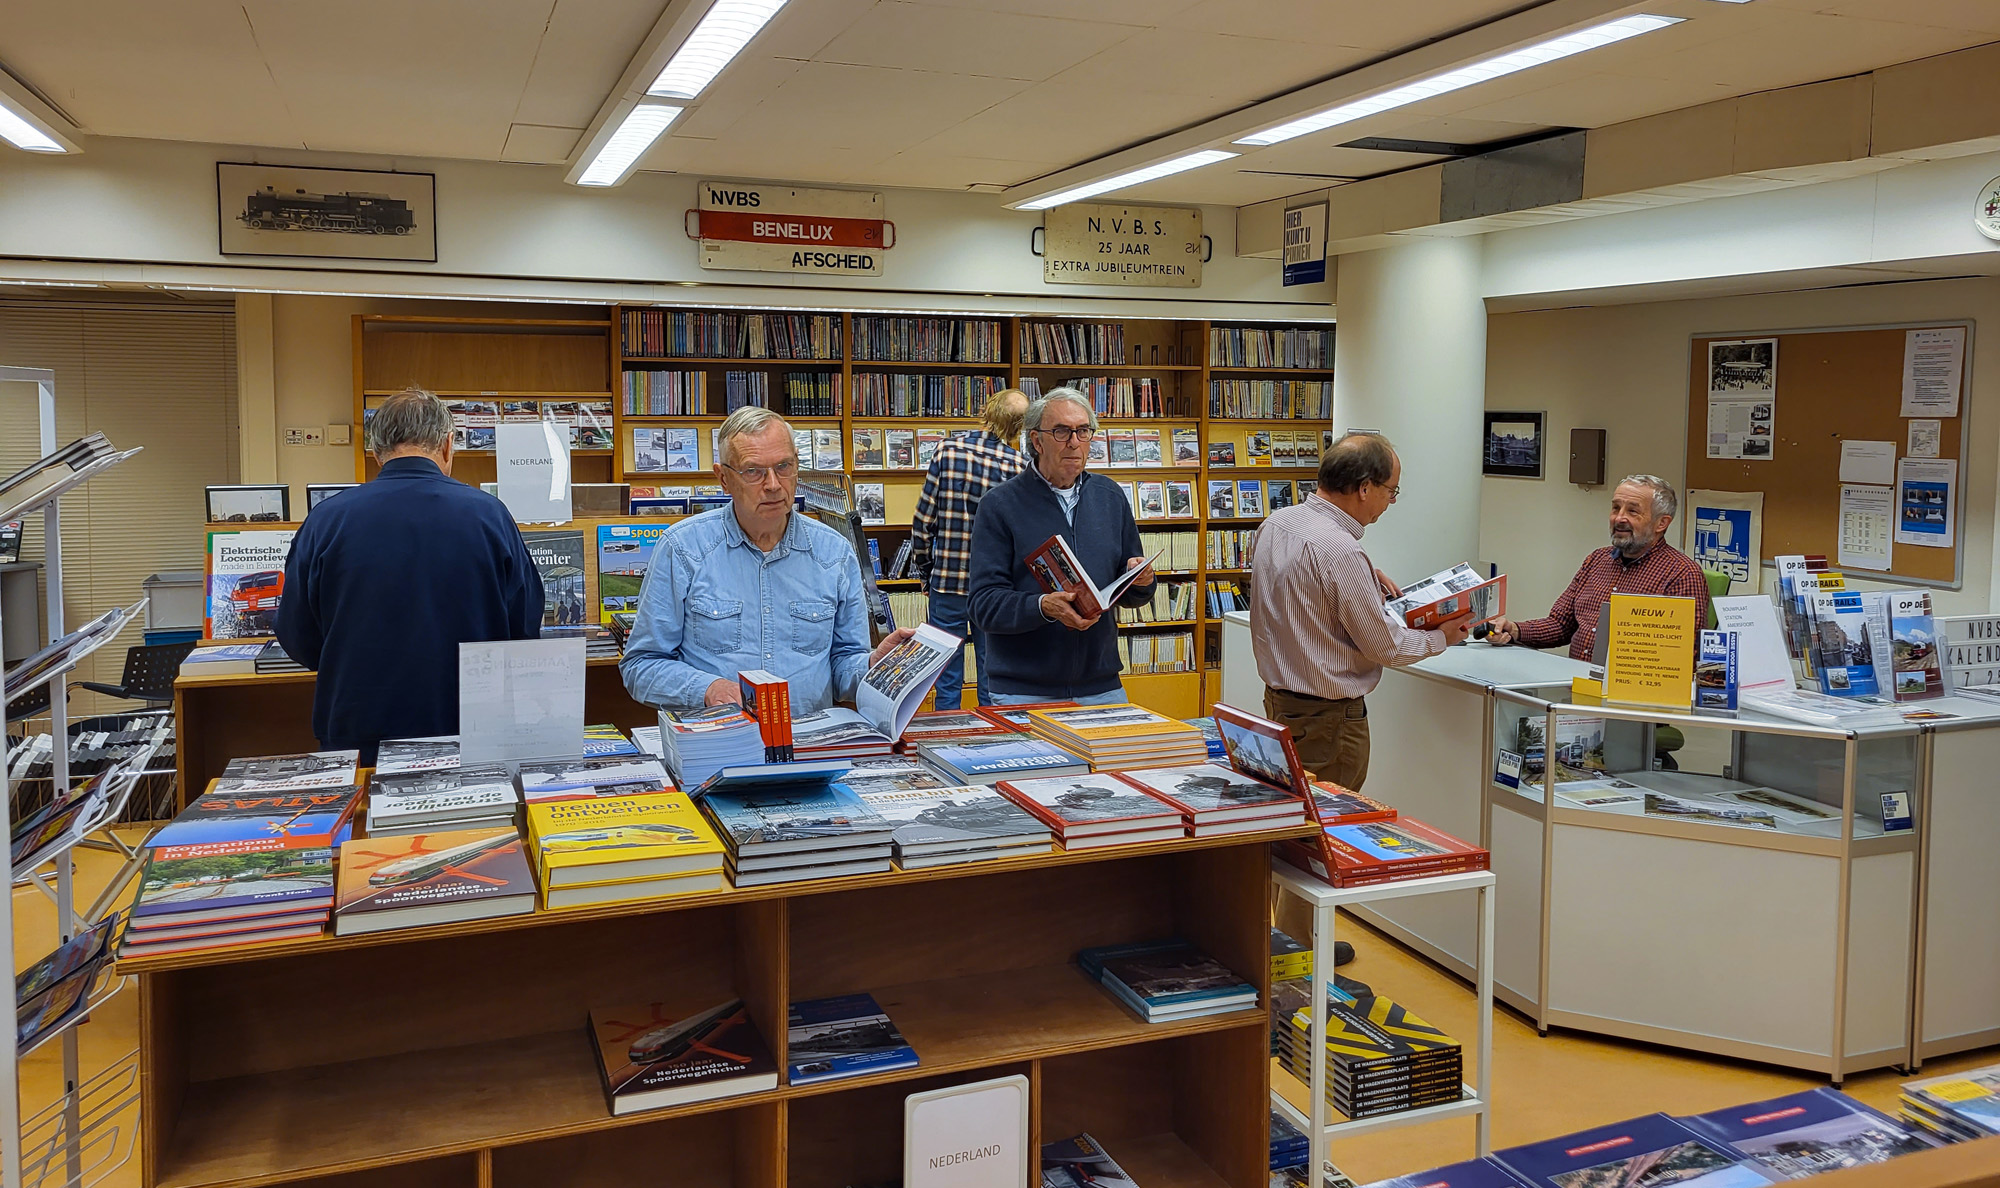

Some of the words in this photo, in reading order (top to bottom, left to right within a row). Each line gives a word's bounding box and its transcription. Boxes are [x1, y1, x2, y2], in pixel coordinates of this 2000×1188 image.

[711, 190, 761, 207] NVBS
[1088, 217, 1105, 233] N.
[1112, 218, 1126, 234] V.
[1134, 219, 1147, 235] B.
[1154, 220, 1167, 236] S.
[1286, 211, 1302, 229] HIER
[752, 221, 833, 240] BENELUX
[1286, 227, 1304, 246] KUNT
[1305, 226, 1311, 243] U
[1098, 242, 1112, 253] 25
[1119, 243, 1151, 256] JAAR
[1286, 244, 1311, 263] PINNEN
[1053, 261, 1091, 272] EXTRA
[1095, 262, 1185, 275] JUBILEUMTREIN
[509, 457, 554, 466] NEDERLAND
[668, 488, 690, 496] AyrLine
[220, 546, 282, 555] Elektrische
[527, 547, 553, 555] tation
[220, 554, 288, 563] Locomotieve
[533, 555, 571, 565] venter
[220, 562, 244, 570] made
[246, 562, 254, 570] in
[1786, 562, 1796, 570] OP
[1801, 580, 1809, 588] OP
[1810, 580, 1818, 588] DE
[1819, 580, 1840, 588] RAILS
[1899, 601, 1913, 609] OP
[1631, 608, 1665, 618] NIEUW
[1642, 622, 1682, 631] WERKLAMPJE
[1968, 621, 2000, 639] NVBS
[1623, 631, 1651, 639] SOORTEN
[1703, 647, 1727, 655] NVBS
[971, 755, 1071, 771] AMSTERDAM
[862, 791, 925, 801] Stoom
[926, 789, 954, 798] bij
[955, 786, 982, 794] NS
[201, 794, 342, 810] ATLAS
[548, 800, 636, 812] Treinen
[550, 802, 680, 819] ontwerpen
[578, 814, 631, 822] Nederlandse
[164, 851, 182, 859] in
[185, 843, 285, 858] Nederland
[165, 838, 276, 853] Kopstations
[393, 884, 481, 898] Nederlandse
[436, 881, 463, 890] jaar
[254, 891, 284, 899] Frank
[374, 886, 499, 905] Spoorwegaffiches
[1361, 1055, 1408, 1068] WAGENWERKPLAATS
[642, 1064, 746, 1084] Spoorwegaffiches
[656, 1061, 729, 1077] Nederlandse
[1364, 1066, 1410, 1079] WAGENWERKPLAATS
[1364, 1075, 1410, 1088] WAGENWERKPLAATS
[1363, 1084, 1409, 1097] WAGENWERKPLAATS
[1363, 1094, 1409, 1107] WAGENWERKPLAATS
[1363, 1103, 1409, 1116] WAGENWERKPLAATS
[929, 1144, 1001, 1169] NEDERLAND
